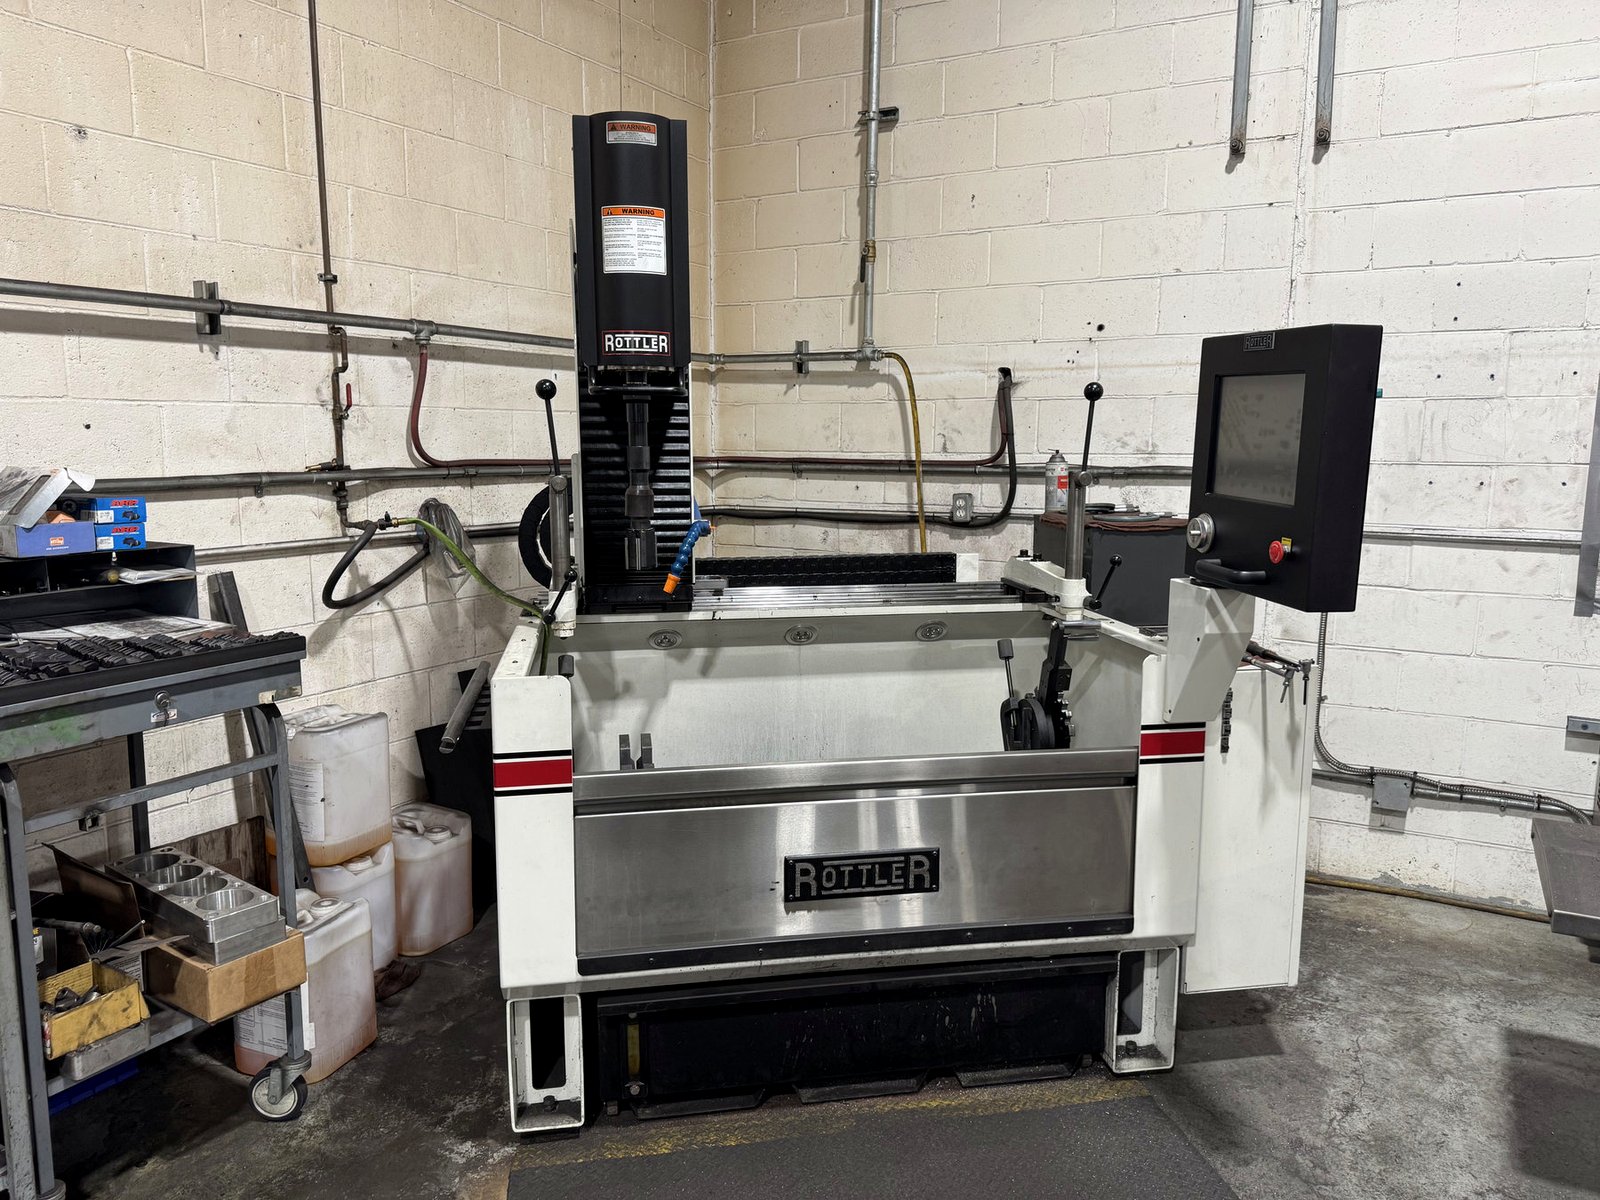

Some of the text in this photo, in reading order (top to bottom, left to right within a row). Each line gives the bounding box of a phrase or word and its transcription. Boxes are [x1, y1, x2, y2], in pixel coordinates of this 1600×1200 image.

[620, 123, 651, 132] WARNING
[621, 208, 655, 216] WARNING
[605, 334, 668, 353] ROTTLER
[1245, 335, 1272, 349] ROTTLER
[795, 855, 931, 898] ROTTLER
